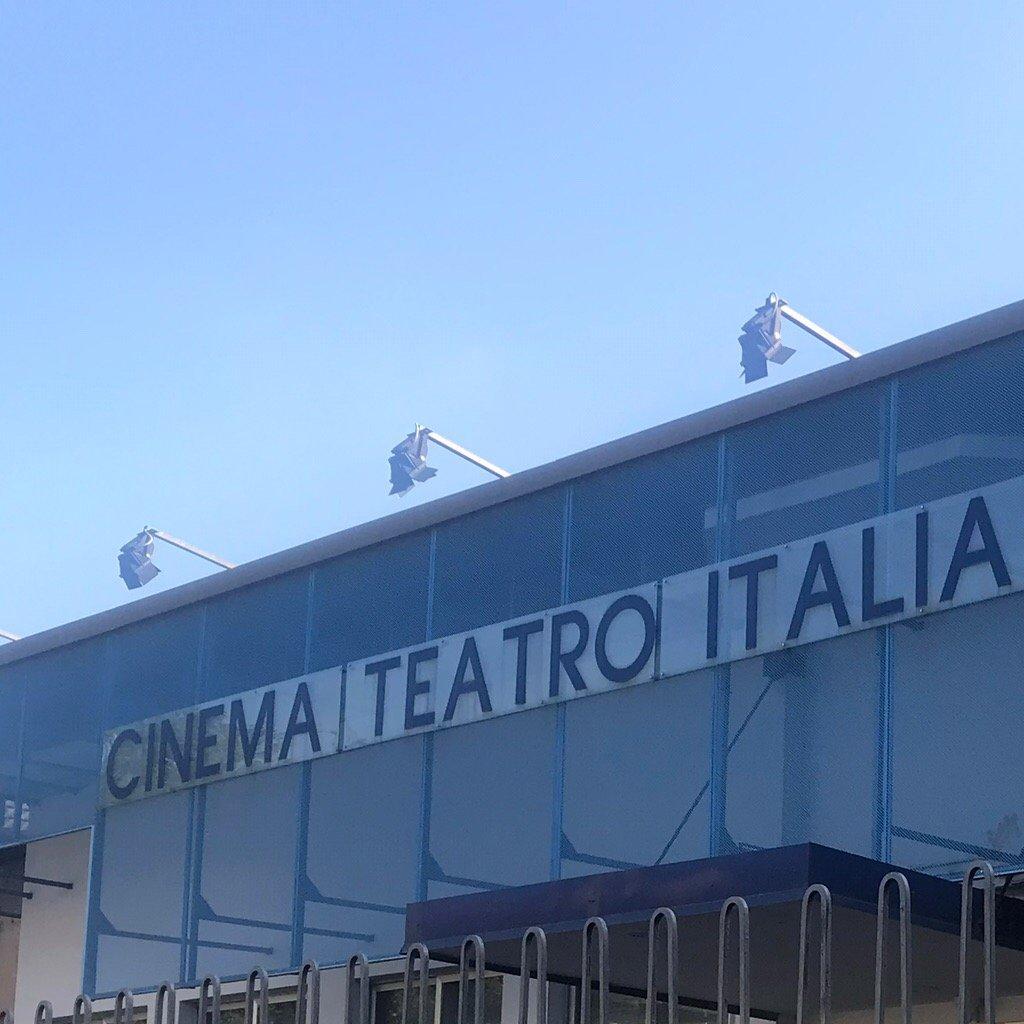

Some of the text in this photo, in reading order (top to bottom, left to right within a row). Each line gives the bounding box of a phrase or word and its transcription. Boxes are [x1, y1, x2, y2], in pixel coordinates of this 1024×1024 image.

[107, 495, 1012, 800] CINEMA TEATRO ITALIA
